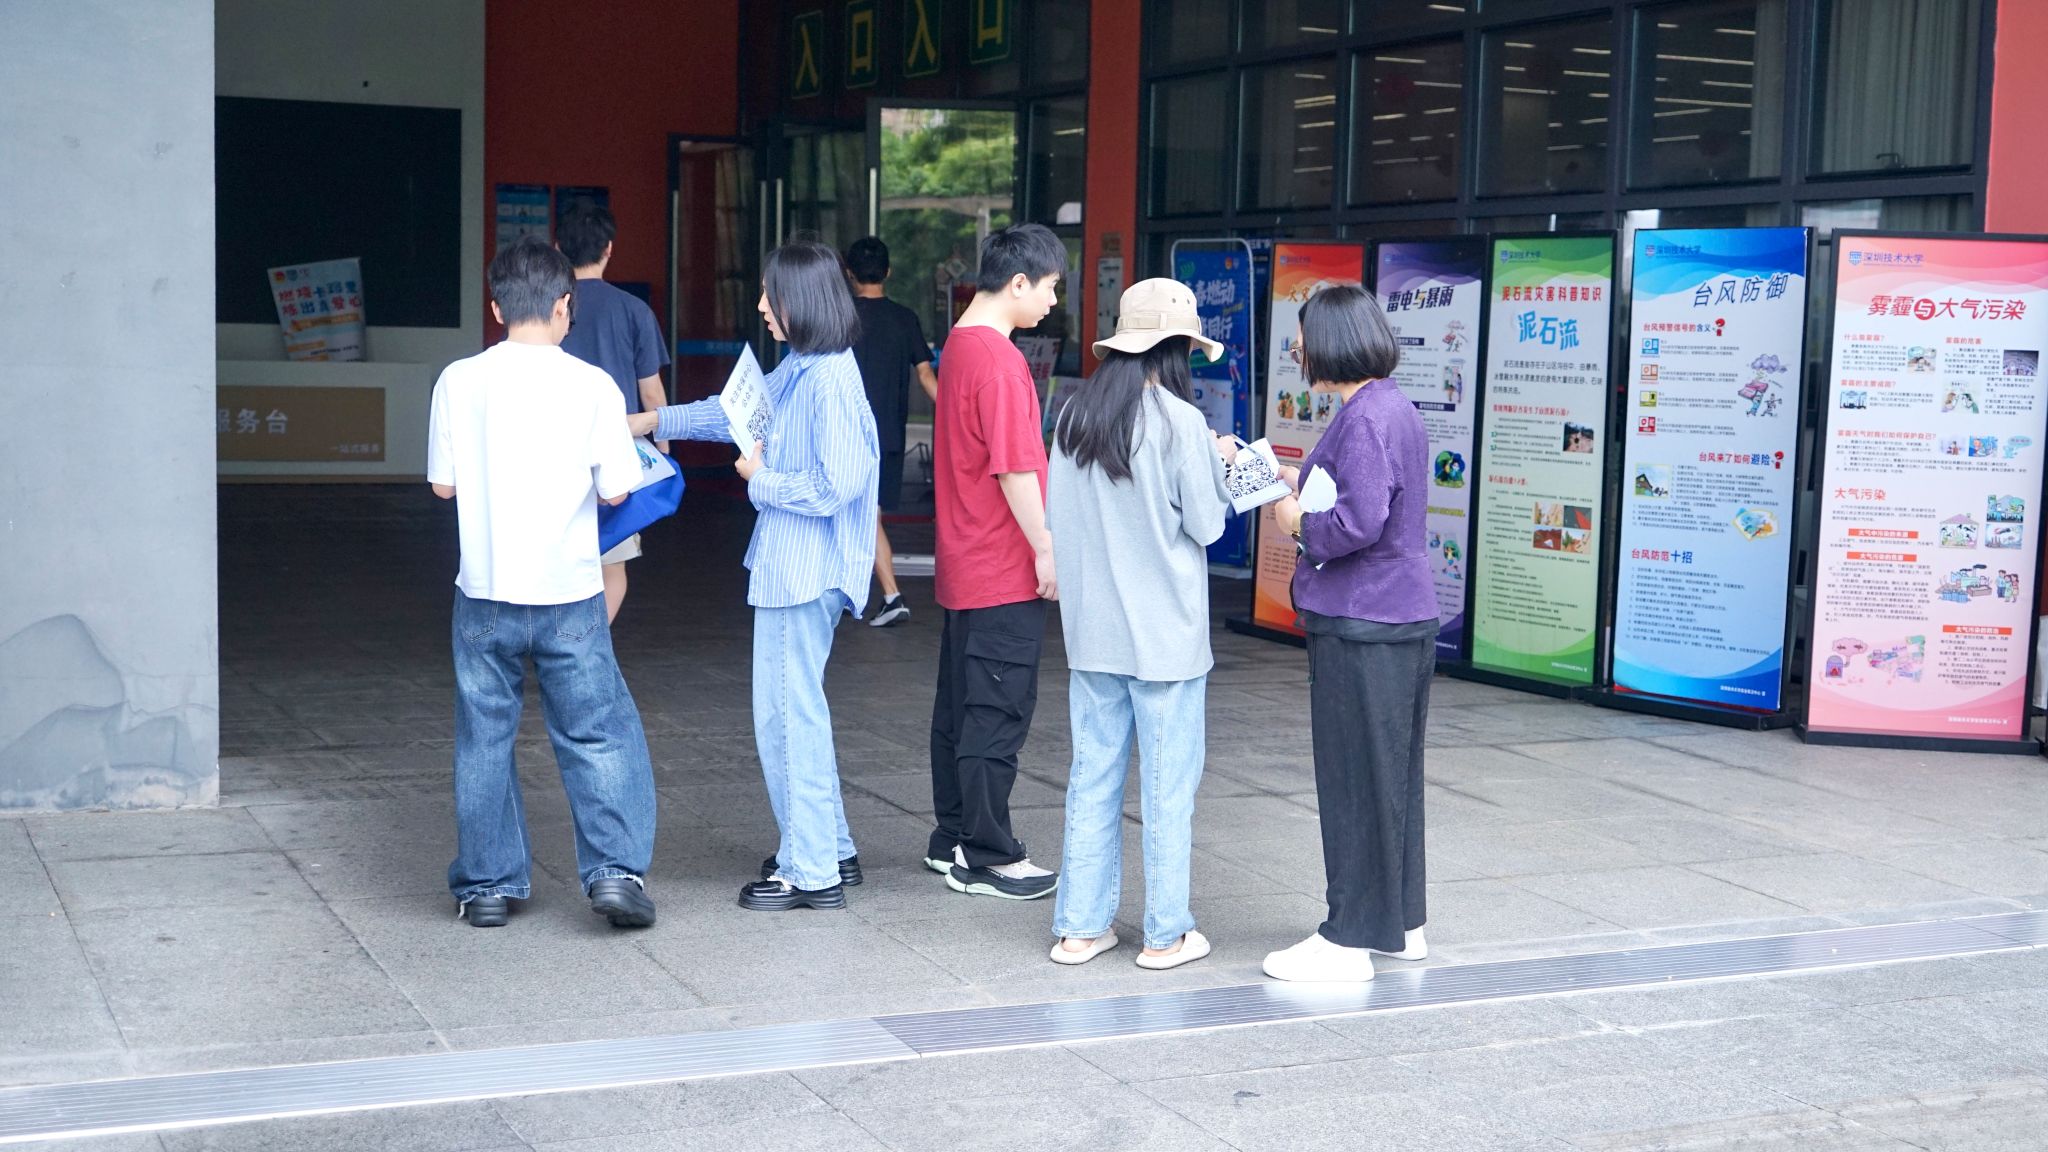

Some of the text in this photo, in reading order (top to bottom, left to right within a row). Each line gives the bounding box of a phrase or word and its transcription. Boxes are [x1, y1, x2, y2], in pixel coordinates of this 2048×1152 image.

[1863, 252, 1924, 265] 深圳技术大学
[1386, 284, 1456, 313] 雷电与暴雨
[1502, 285, 1602, 302] 泥石流灾害科普知识
[1693, 273, 1790, 308] 台风防御
[1867, 294, 2028, 321] 雾霾与大气污染
[1517, 310, 1580, 351] 泥石流
[1834, 487, 1887, 502] 大气污染
[1631, 549, 1693, 564] 台风防范十招
